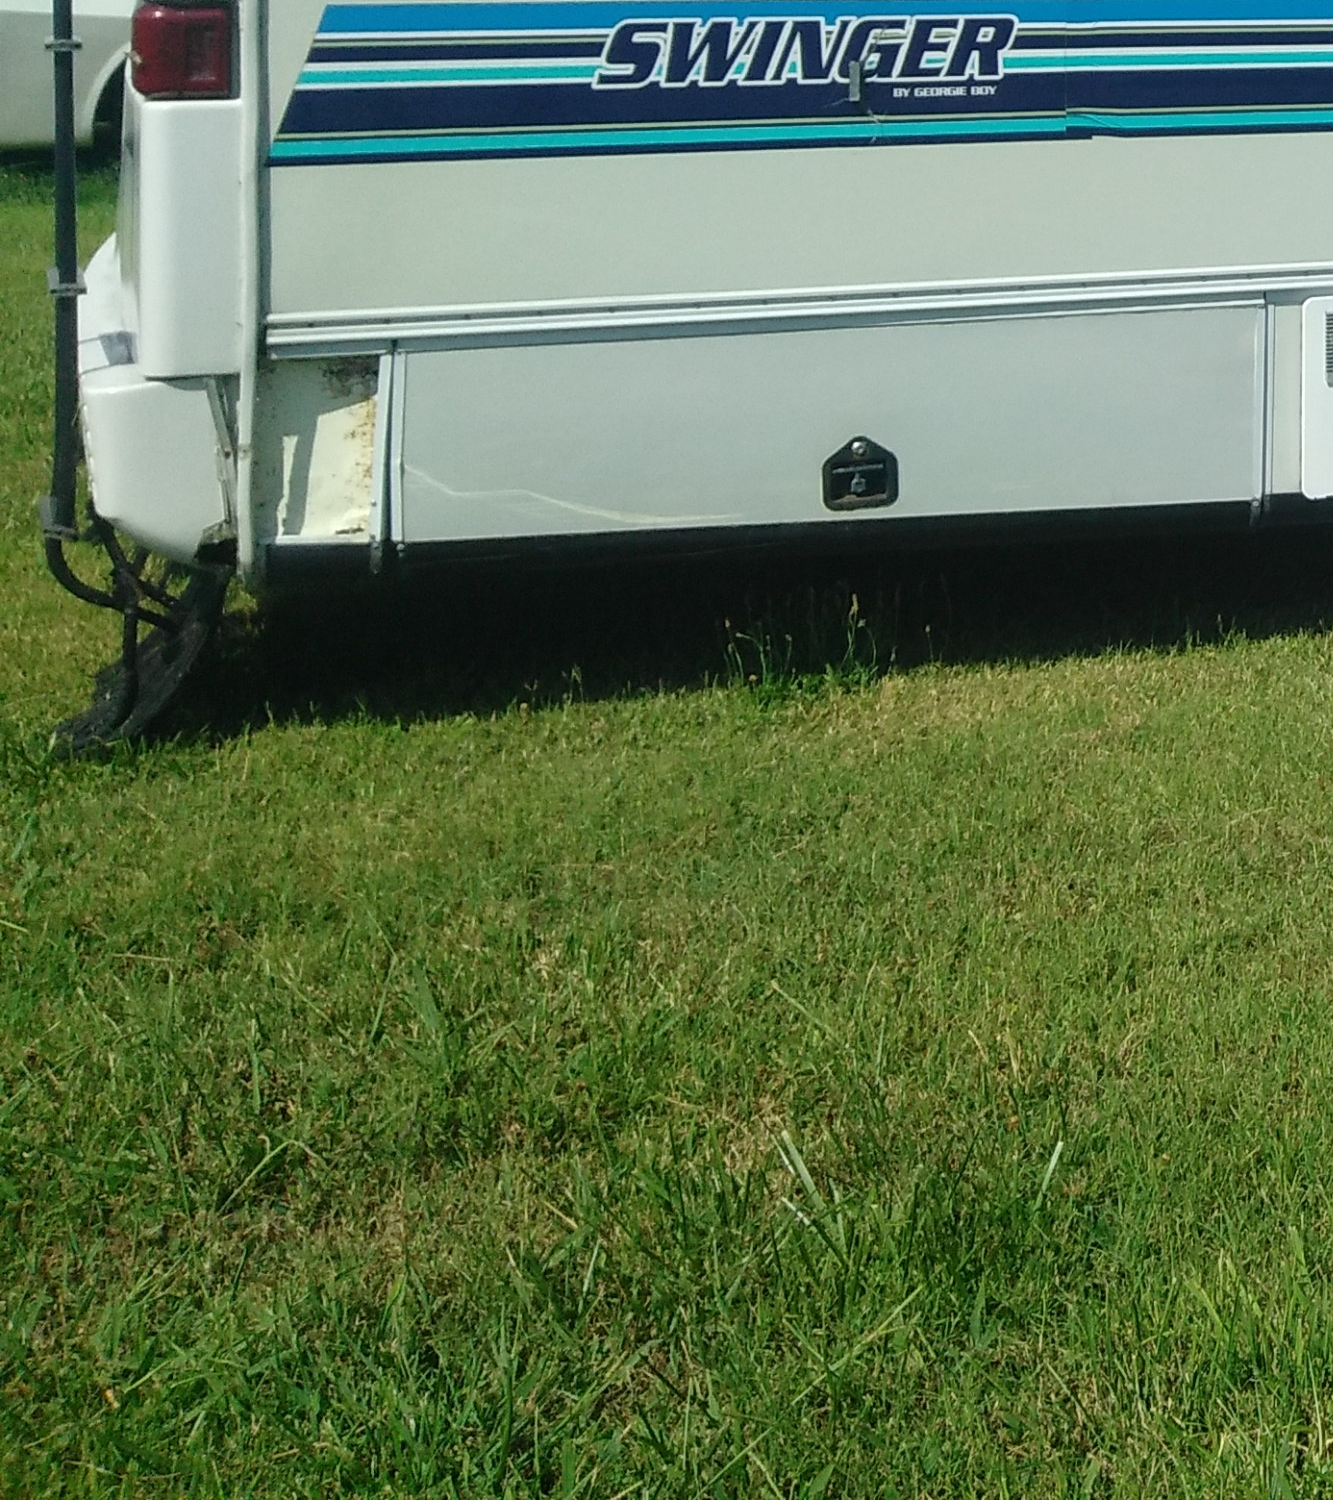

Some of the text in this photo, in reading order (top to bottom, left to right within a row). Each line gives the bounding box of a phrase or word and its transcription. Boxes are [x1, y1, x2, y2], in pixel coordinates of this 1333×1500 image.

[592, 14, 1019, 89] SWINGER
[893, 85, 997, 98] BY GEORGIE BOY
